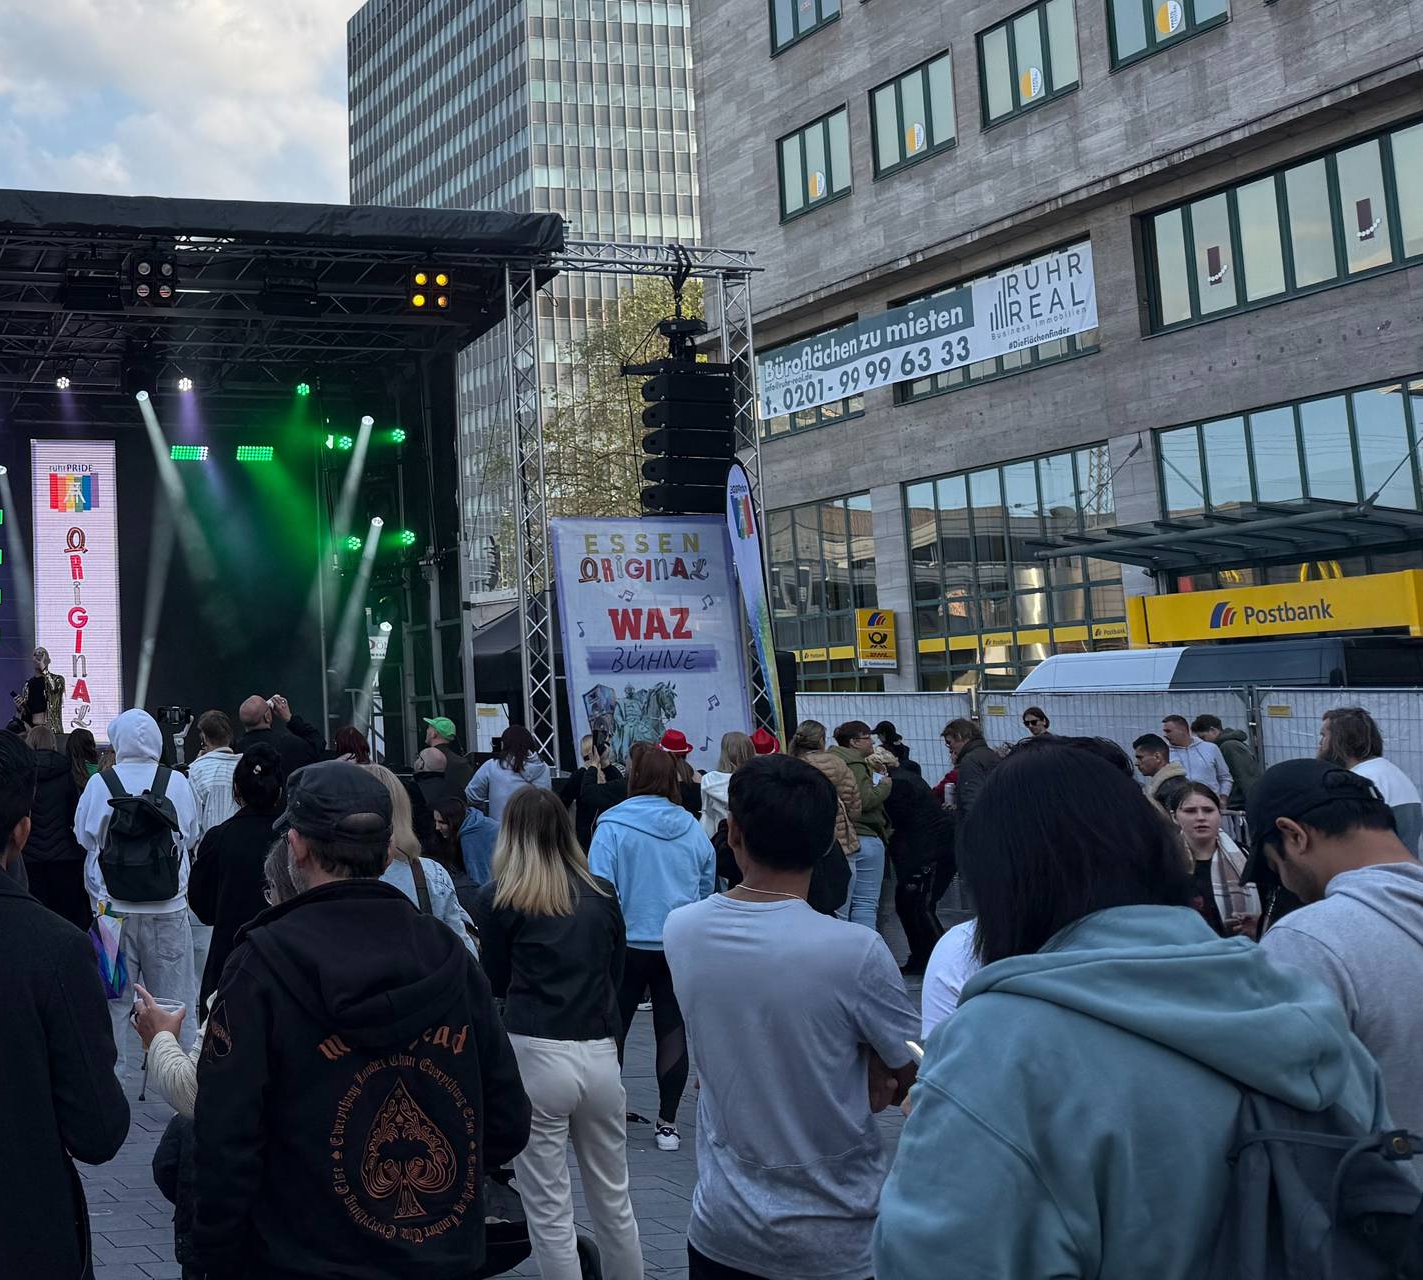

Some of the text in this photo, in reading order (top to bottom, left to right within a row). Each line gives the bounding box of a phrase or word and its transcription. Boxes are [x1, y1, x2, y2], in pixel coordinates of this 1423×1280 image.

[1006, 252, 1082, 297] RUHR
[1008, 282, 1085, 325] REAL
[764, 306, 964, 383] Büroflächen zu mieten
[991, 324, 1031, 341] Business
[839, 366, 860, 394] 99
[865, 356, 892, 385] 99
[900, 346, 932, 376] 63
[940, 336, 971, 366] 33
[583, 533, 700, 555] ESSEN
[608, 607, 693, 641] WAZ
[1244, 599, 1335, 625] Postbank
[611, 645, 698, 674] BÜHNE
